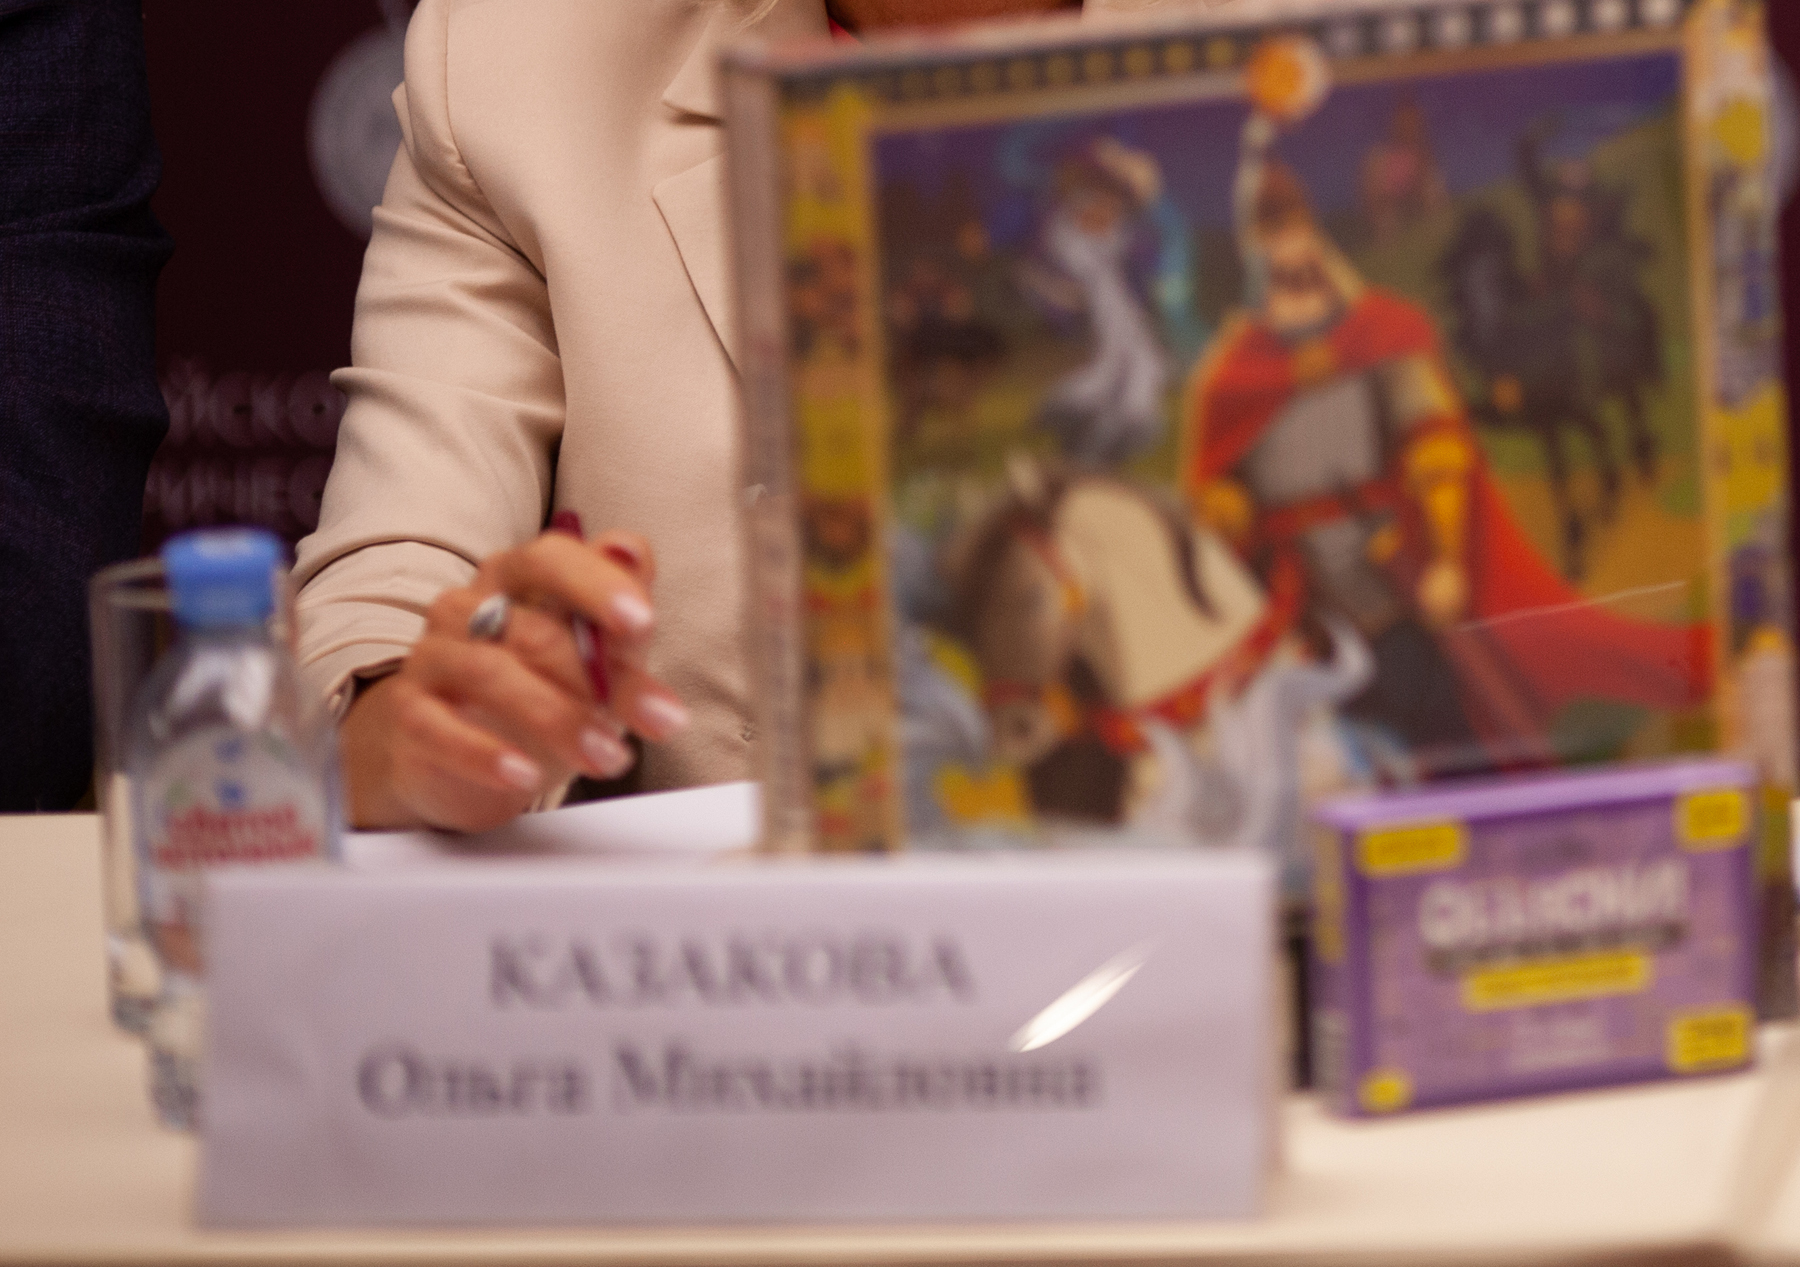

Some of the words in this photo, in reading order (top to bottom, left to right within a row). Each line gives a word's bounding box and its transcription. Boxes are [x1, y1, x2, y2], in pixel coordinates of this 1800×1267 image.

[487, 929, 974, 1008] КАЗАКОВА
[354, 1044, 588, 1120] Ольга
[612, 1036, 1102, 1114] Михайловна
